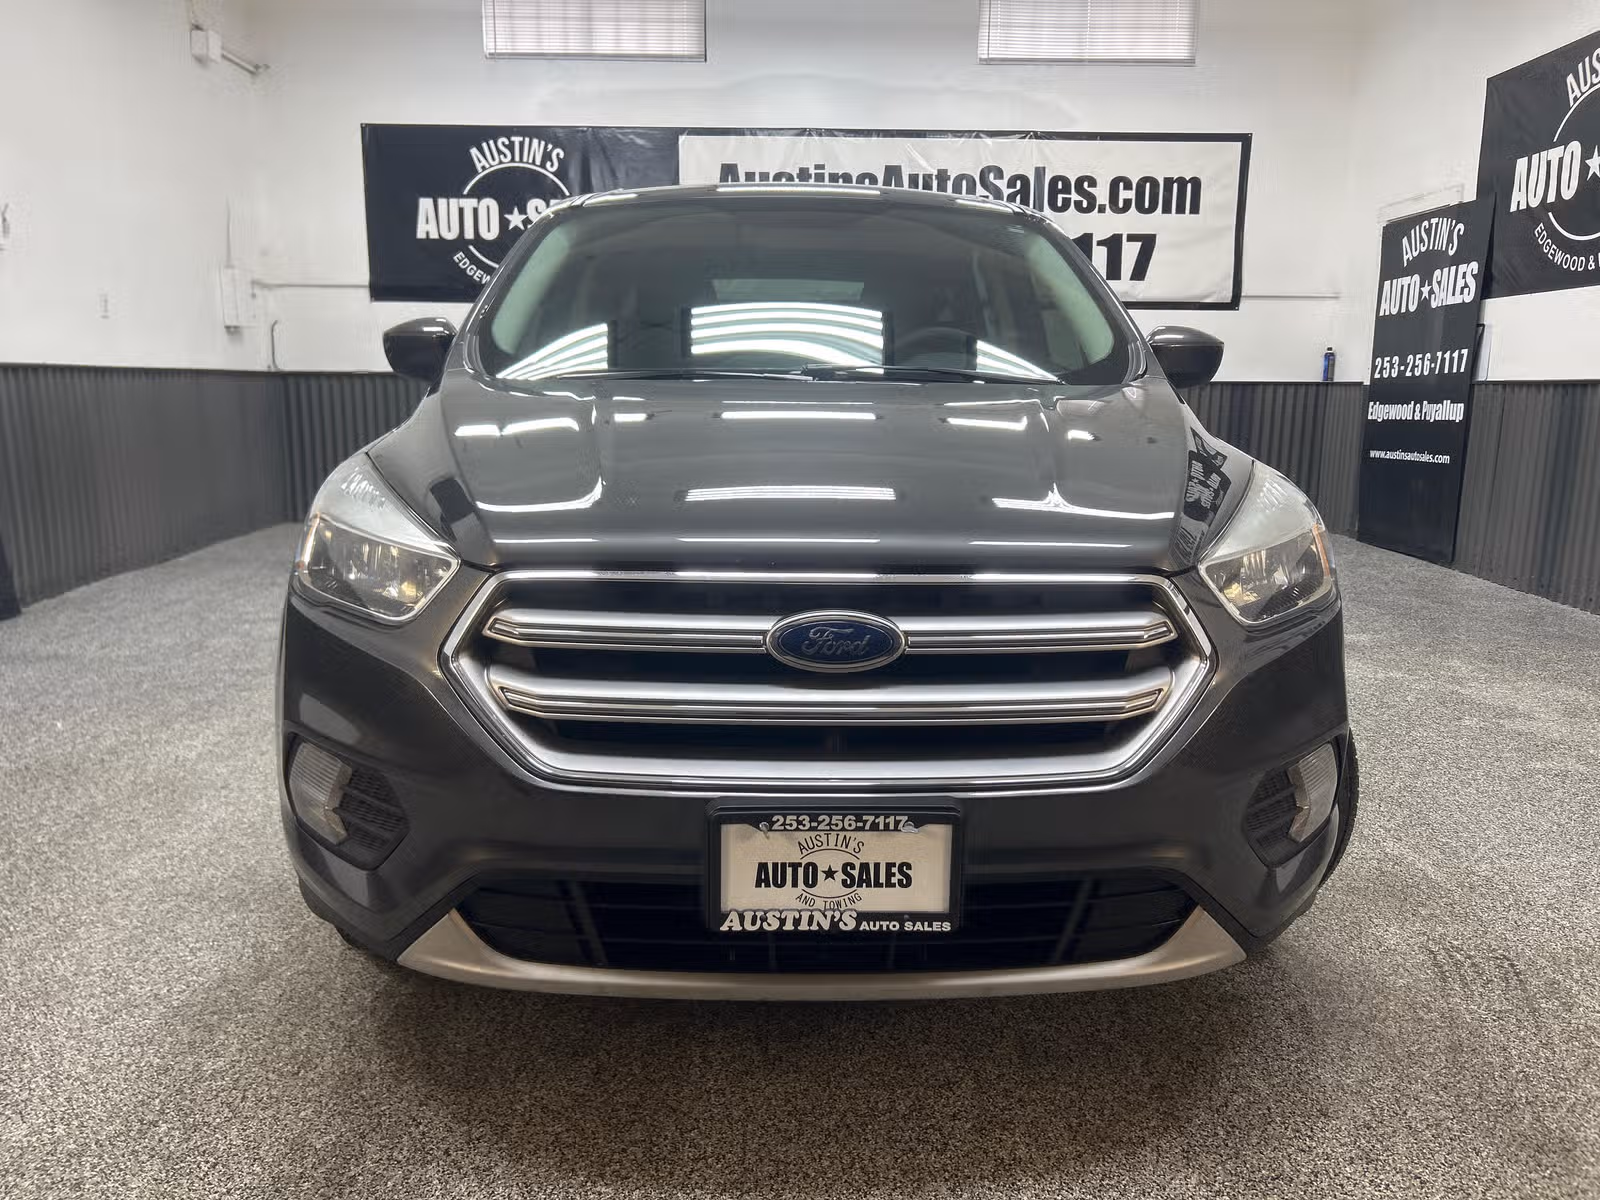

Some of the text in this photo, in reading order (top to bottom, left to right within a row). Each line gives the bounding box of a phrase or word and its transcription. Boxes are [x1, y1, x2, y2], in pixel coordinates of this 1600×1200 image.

[469, 136, 565, 173] AUSTIN'S
[720, 164, 1202, 215] toSales.com
[1510, 140, 1582, 213] AUTO
[416, 197, 500, 240] AUTO
[1402, 217, 1465, 267] AUSTIN'S
[1534, 222, 1586, 271] EDGEWOOD
[1587, 255, 1595, 270] &
[1379, 261, 1479, 316] AUTO SALES
[1374, 348, 1468, 379] 253-256-7117
[1367, 400, 1465, 422] Edgewood & Puyallup
[1369, 449, 1450, 464] www.austinsautosales.com
[801, 626, 871, 656] Ford
[771, 815, 908, 831] 253-256-7117
[797, 832, 865, 855] AUSTIN'S
[754, 861, 913, 888] AUTO SALES
[796, 892, 862, 910] AND TOWING
[719, 910, 951, 931] AUSTIN'S AUTO SALES
